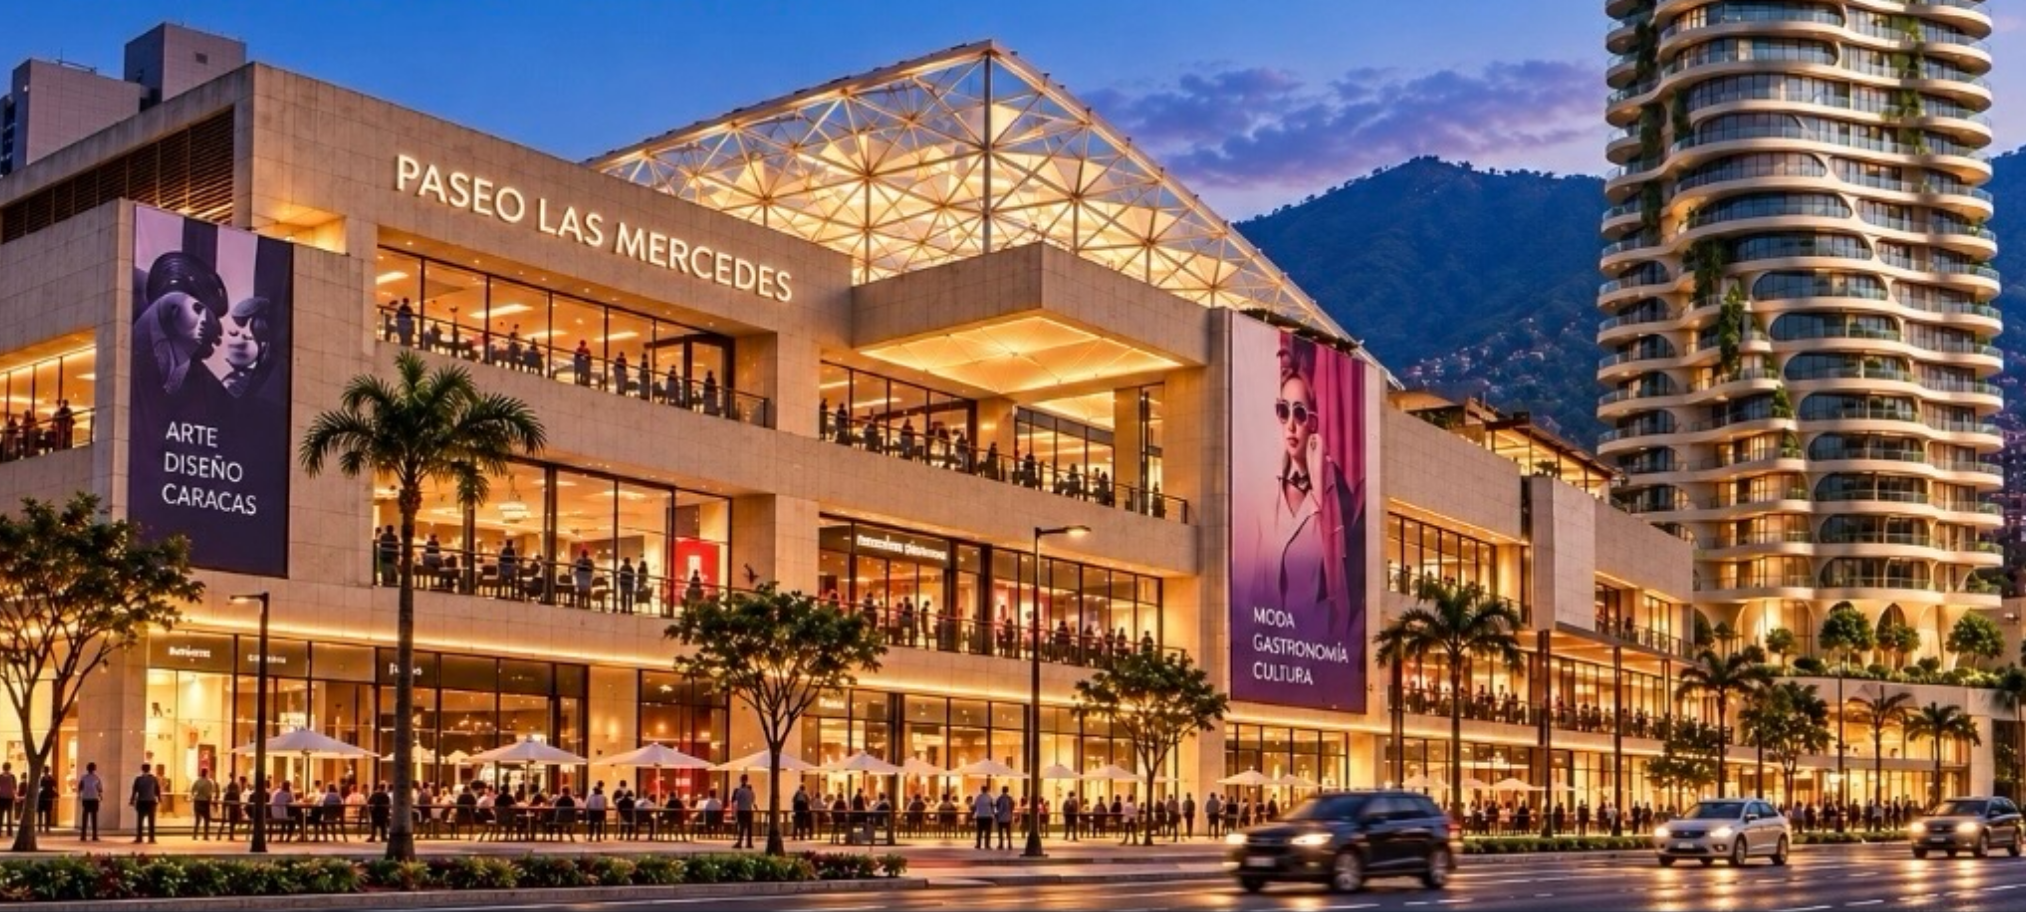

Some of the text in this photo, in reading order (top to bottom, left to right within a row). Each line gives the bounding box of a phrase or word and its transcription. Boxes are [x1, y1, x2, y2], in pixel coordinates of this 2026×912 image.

[396, 154, 793, 303] PASEO LAS MERCEDES
[165, 421, 219, 448] ARTE
[164, 451, 243, 483] DISEÑO
[162, 483, 257, 516] CARACAS
[1253, 606, 1295, 629] MODA
[1253, 633, 1349, 664] GASTRONOMÍA
[1253, 662, 1314, 686] CULTURA
